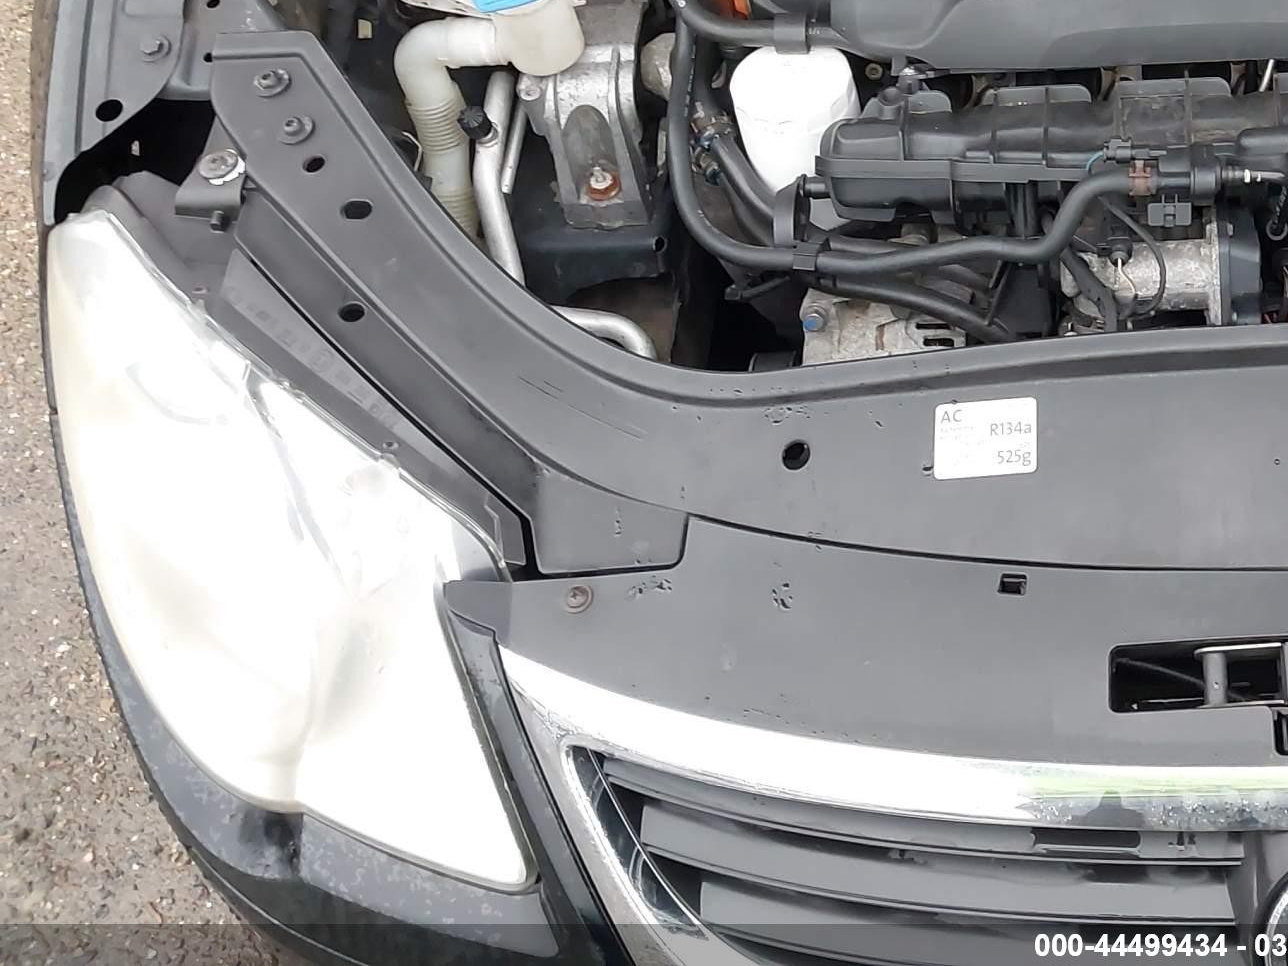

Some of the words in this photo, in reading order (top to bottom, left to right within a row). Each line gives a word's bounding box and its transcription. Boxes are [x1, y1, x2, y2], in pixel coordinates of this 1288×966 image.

[940, 409, 963, 424] AC
[990, 421, 1032, 437] R134a
[997, 449, 1032, 467] 525g
